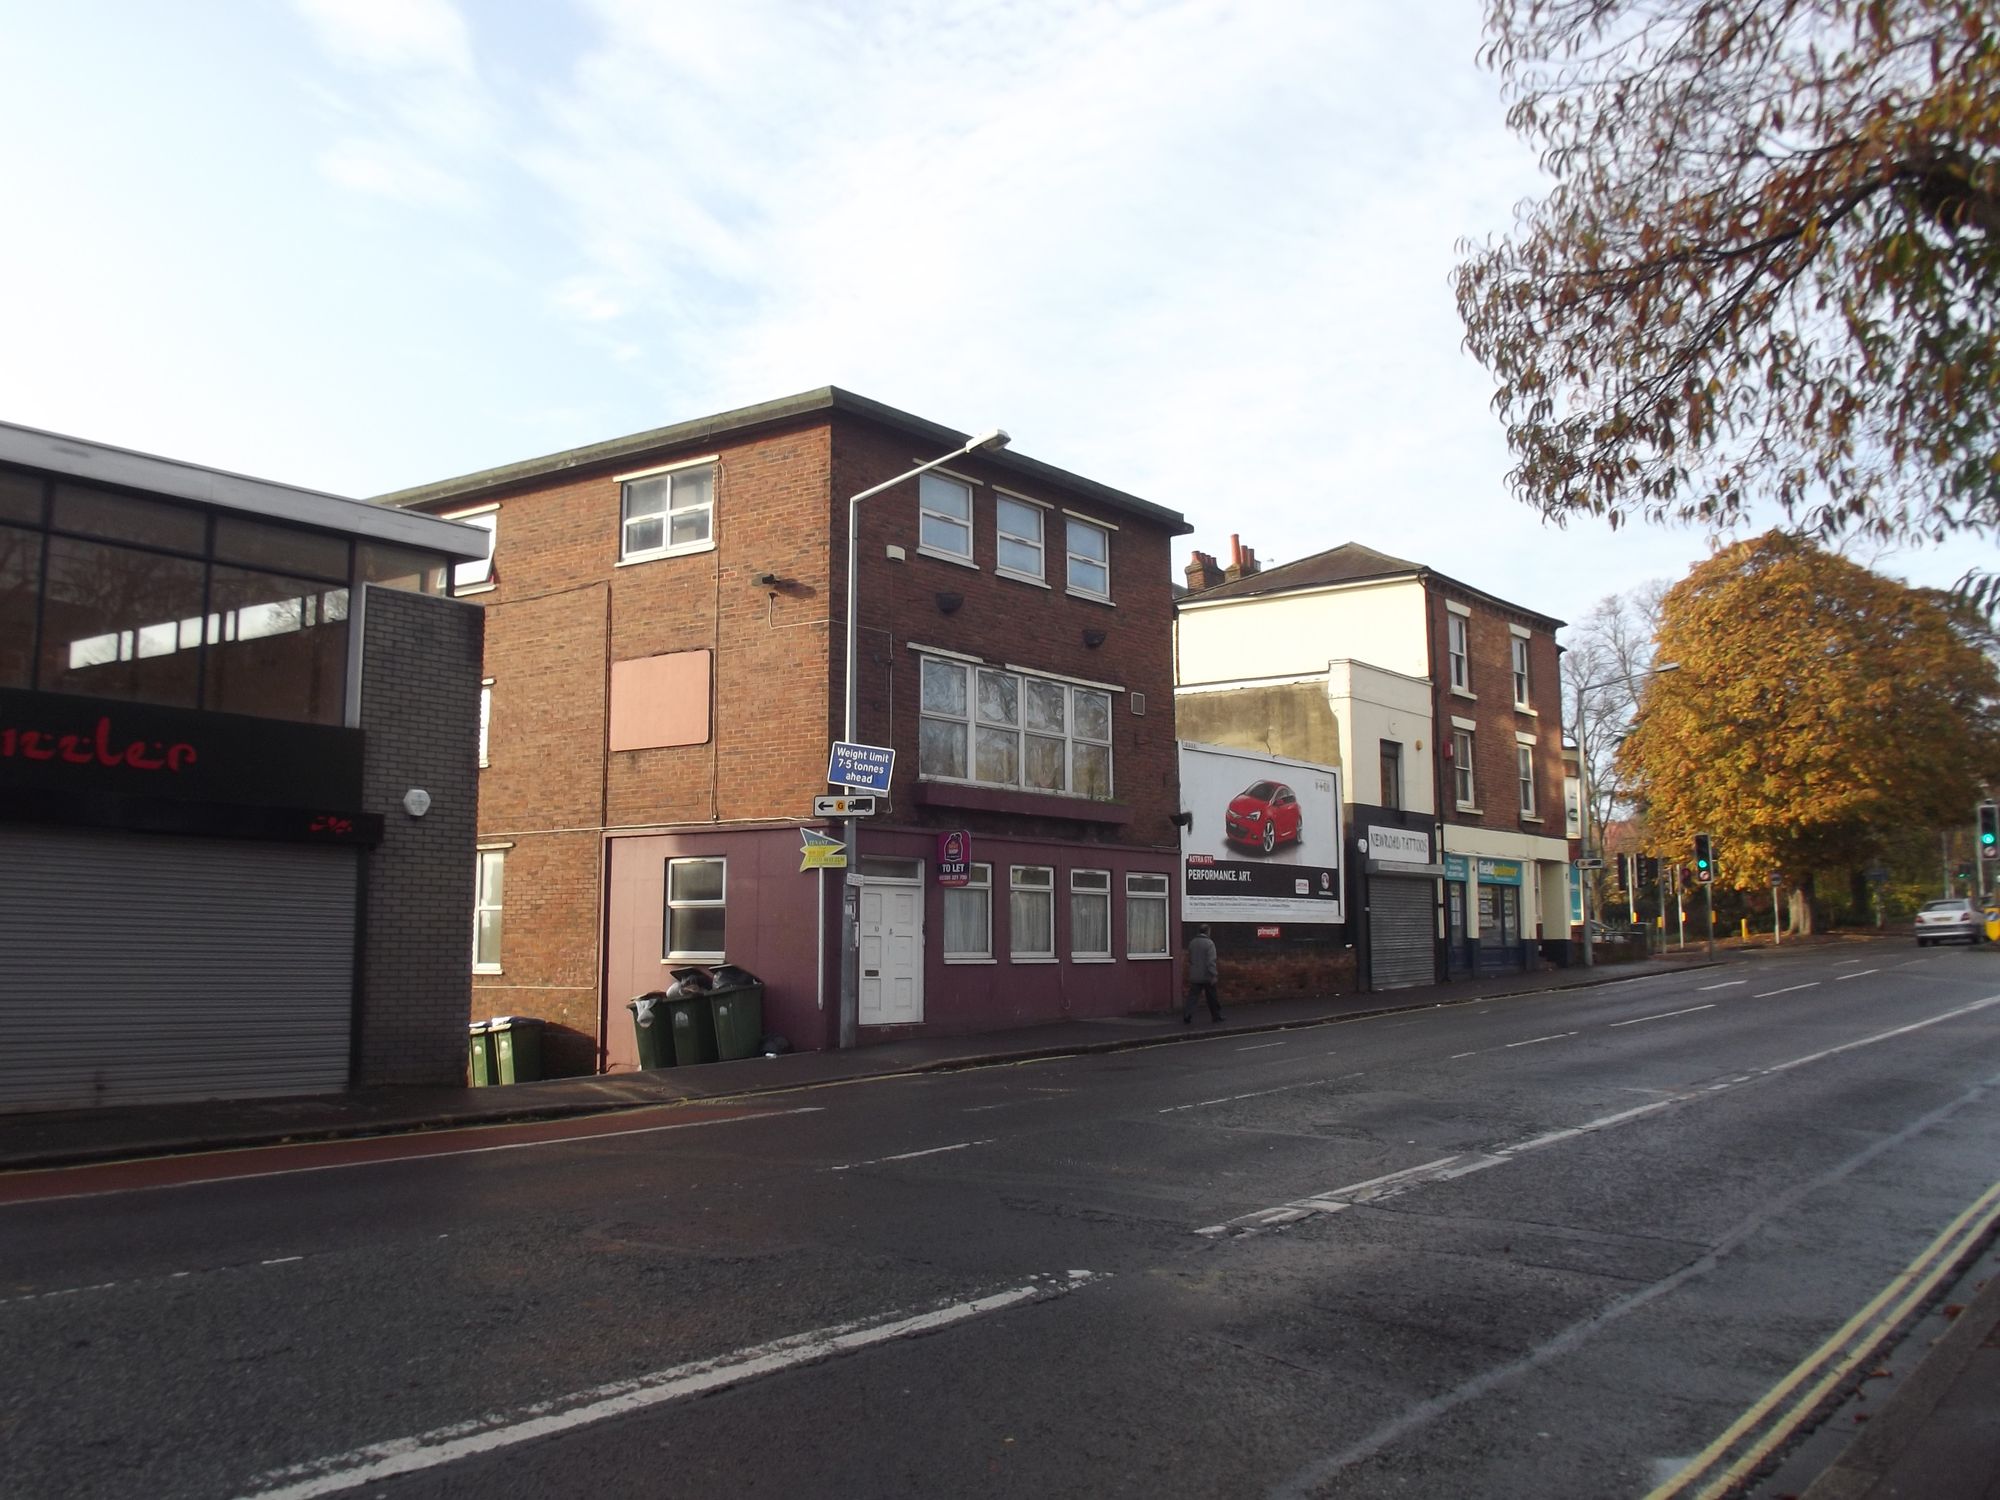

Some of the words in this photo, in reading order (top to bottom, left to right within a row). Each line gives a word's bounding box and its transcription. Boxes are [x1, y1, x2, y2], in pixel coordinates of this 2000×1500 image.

[837, 747, 867, 760] Weight
[869, 752, 889, 763] limit
[854, 761, 884, 774] tonnes
[845, 772, 873, 784] ahead
[942, 863, 951, 873] TO
[952, 863, 965, 873] LET
[1238, 870, 1252, 882] ART.
